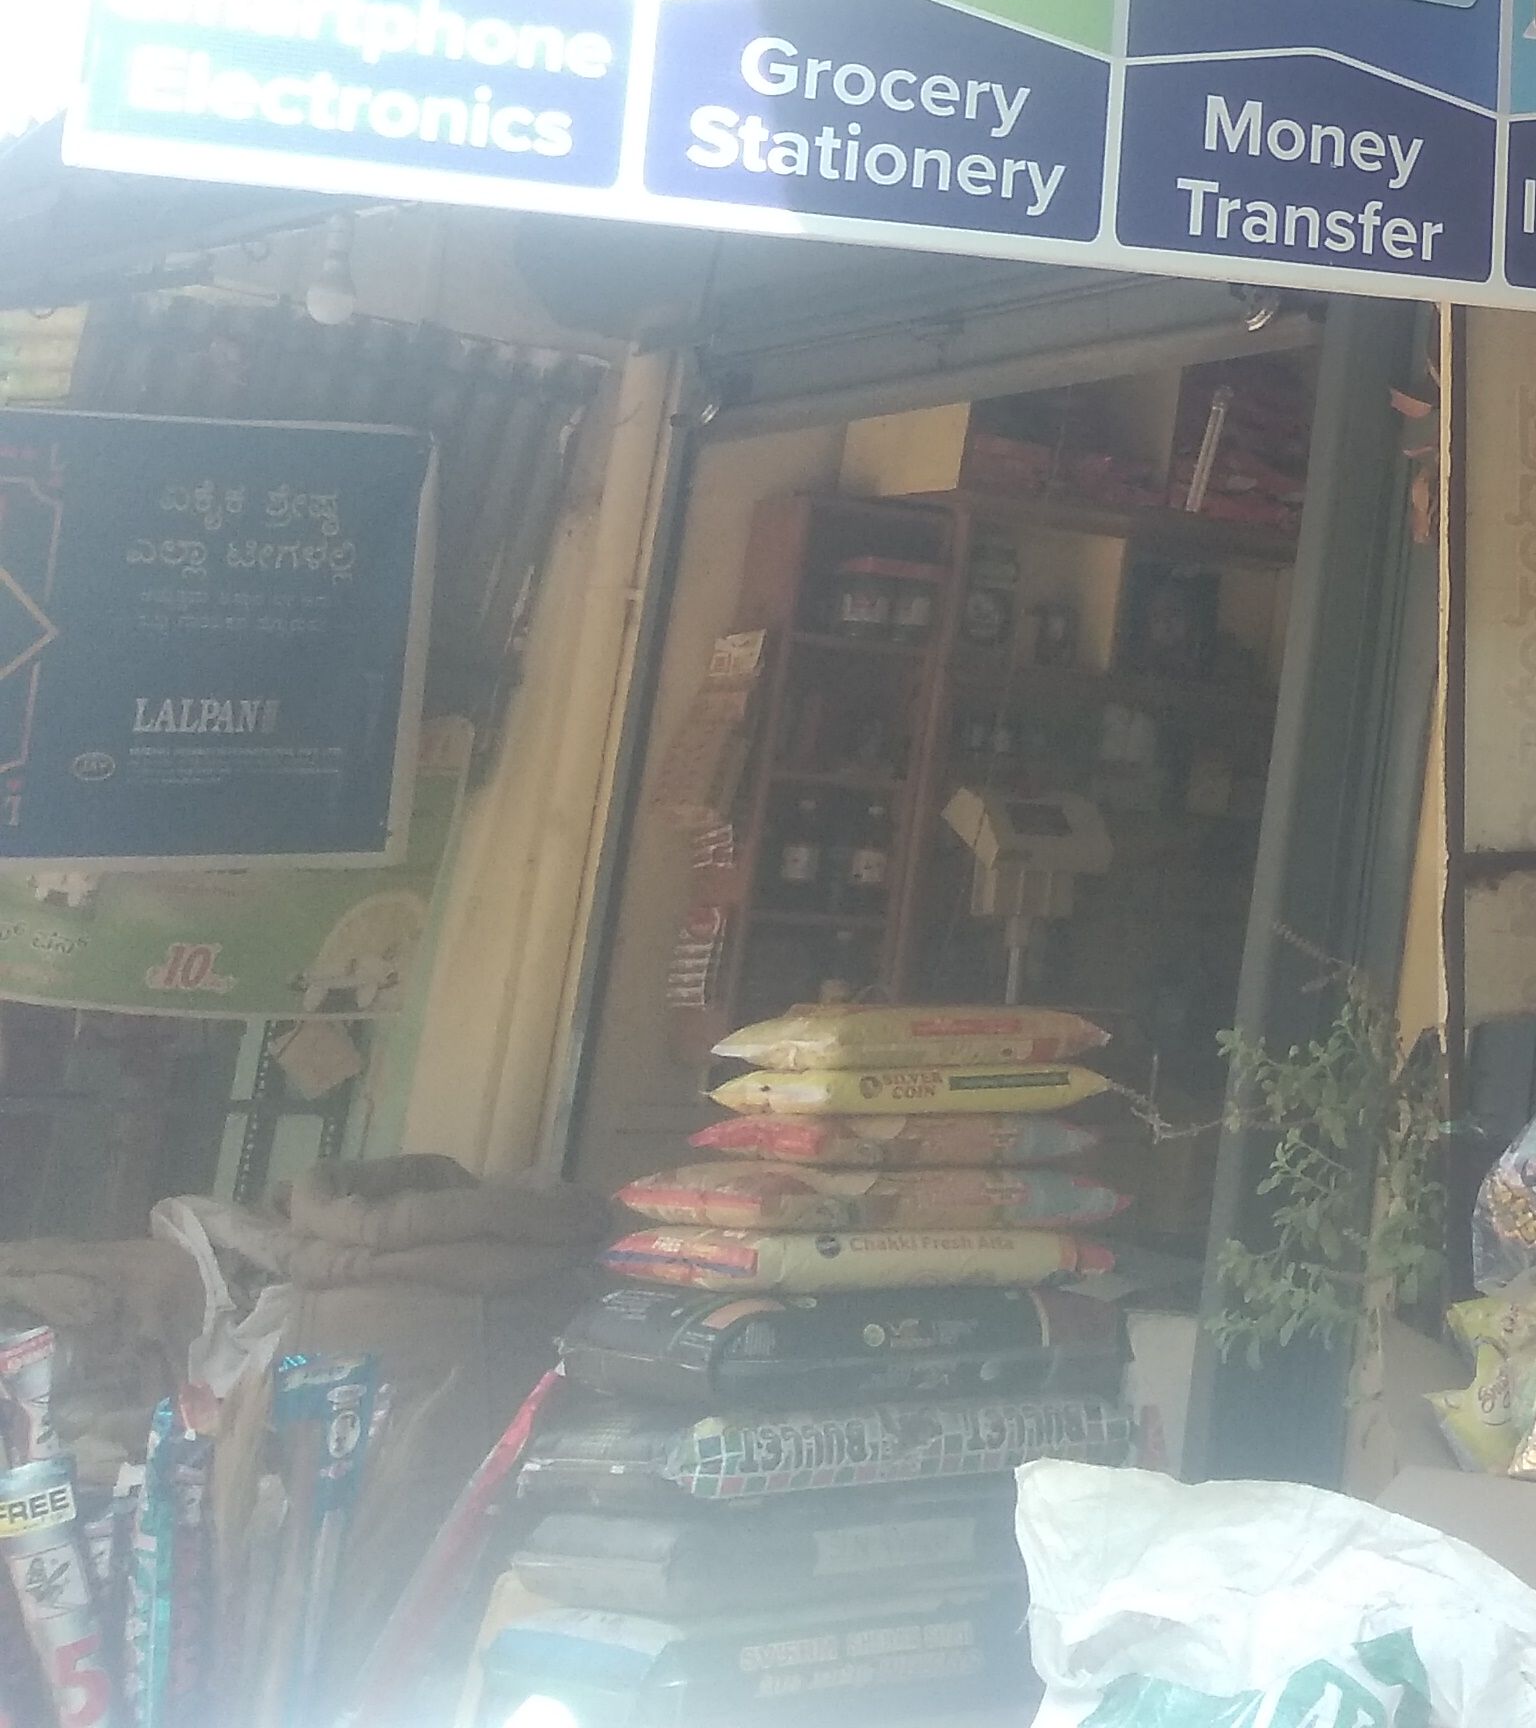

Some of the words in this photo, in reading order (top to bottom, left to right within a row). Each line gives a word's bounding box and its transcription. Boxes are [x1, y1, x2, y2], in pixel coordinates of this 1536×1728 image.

[128, 40, 575, 159] Electronics
[739, 34, 1032, 139] Grocery
[685, 105, 1067, 218] Stationery
[1202, 92, 1425, 188] Money
[1176, 175, 1446, 264] Transfer
[163, 944, 213, 988] 10
[884, 1072, 943, 1086] SILVER
[891, 1085, 937, 1099] COIN
[849, 1235, 918, 1253] Chakki
[920, 1235, 974, 1251] Fresh
